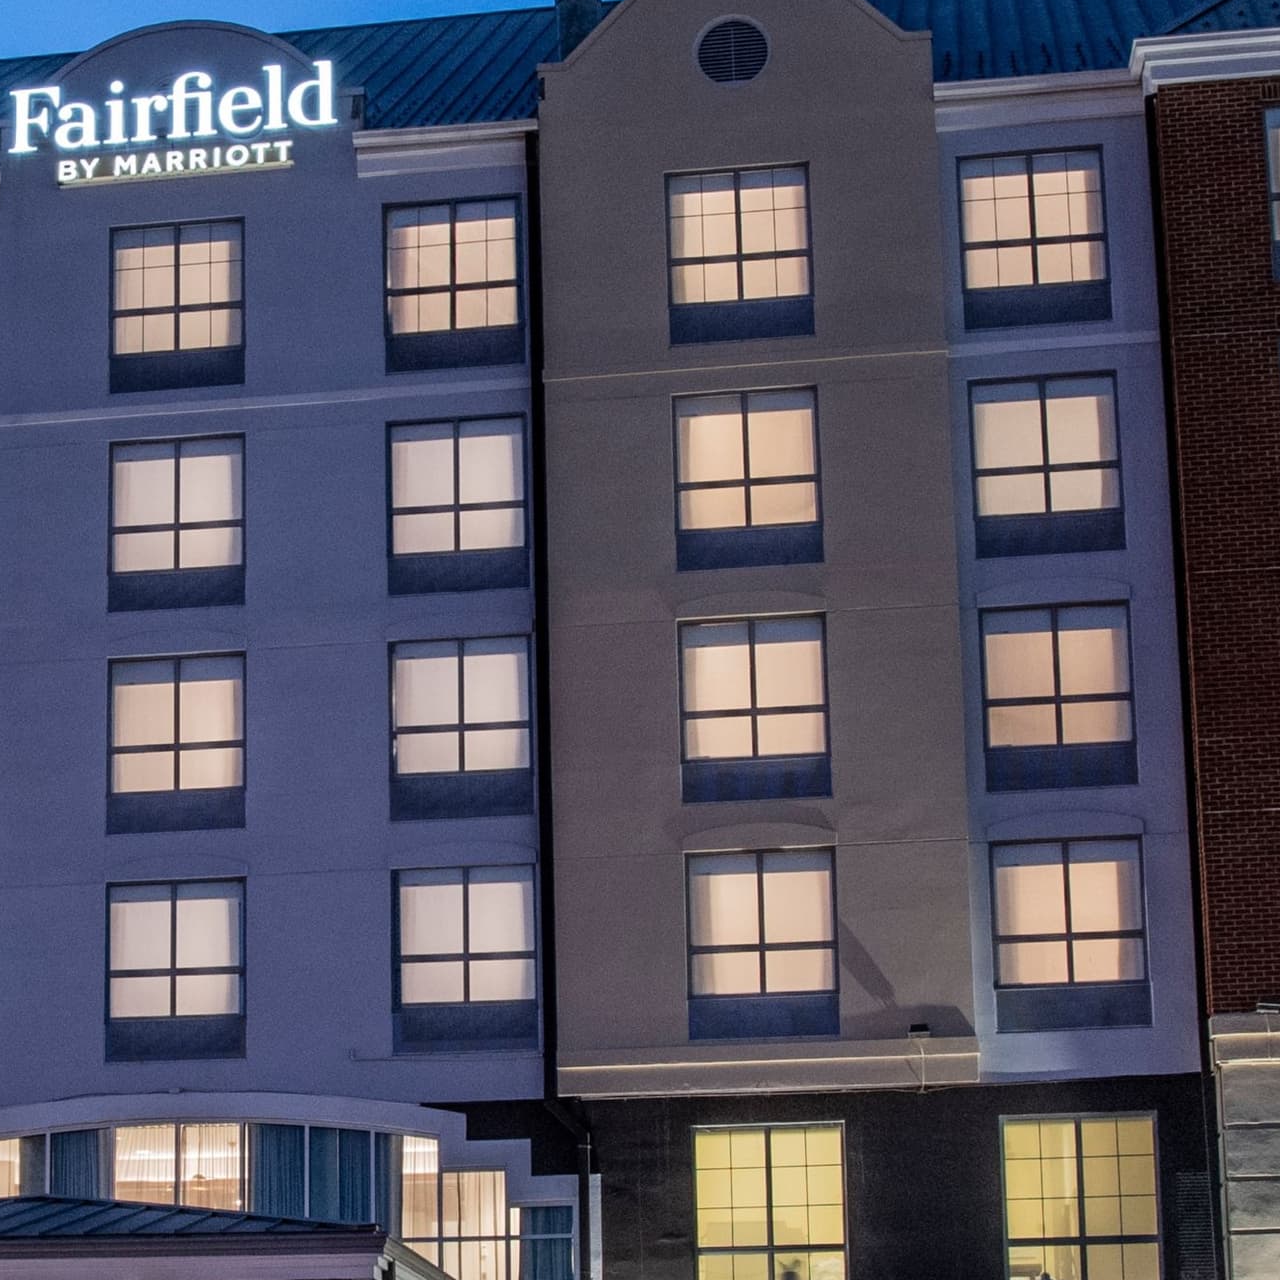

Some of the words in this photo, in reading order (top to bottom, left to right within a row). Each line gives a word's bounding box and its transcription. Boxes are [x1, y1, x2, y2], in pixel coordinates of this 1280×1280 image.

[8, 60, 338, 154] Fairfield
[58, 157, 100, 181] BY
[113, 140, 293, 177] MARRIOTT
